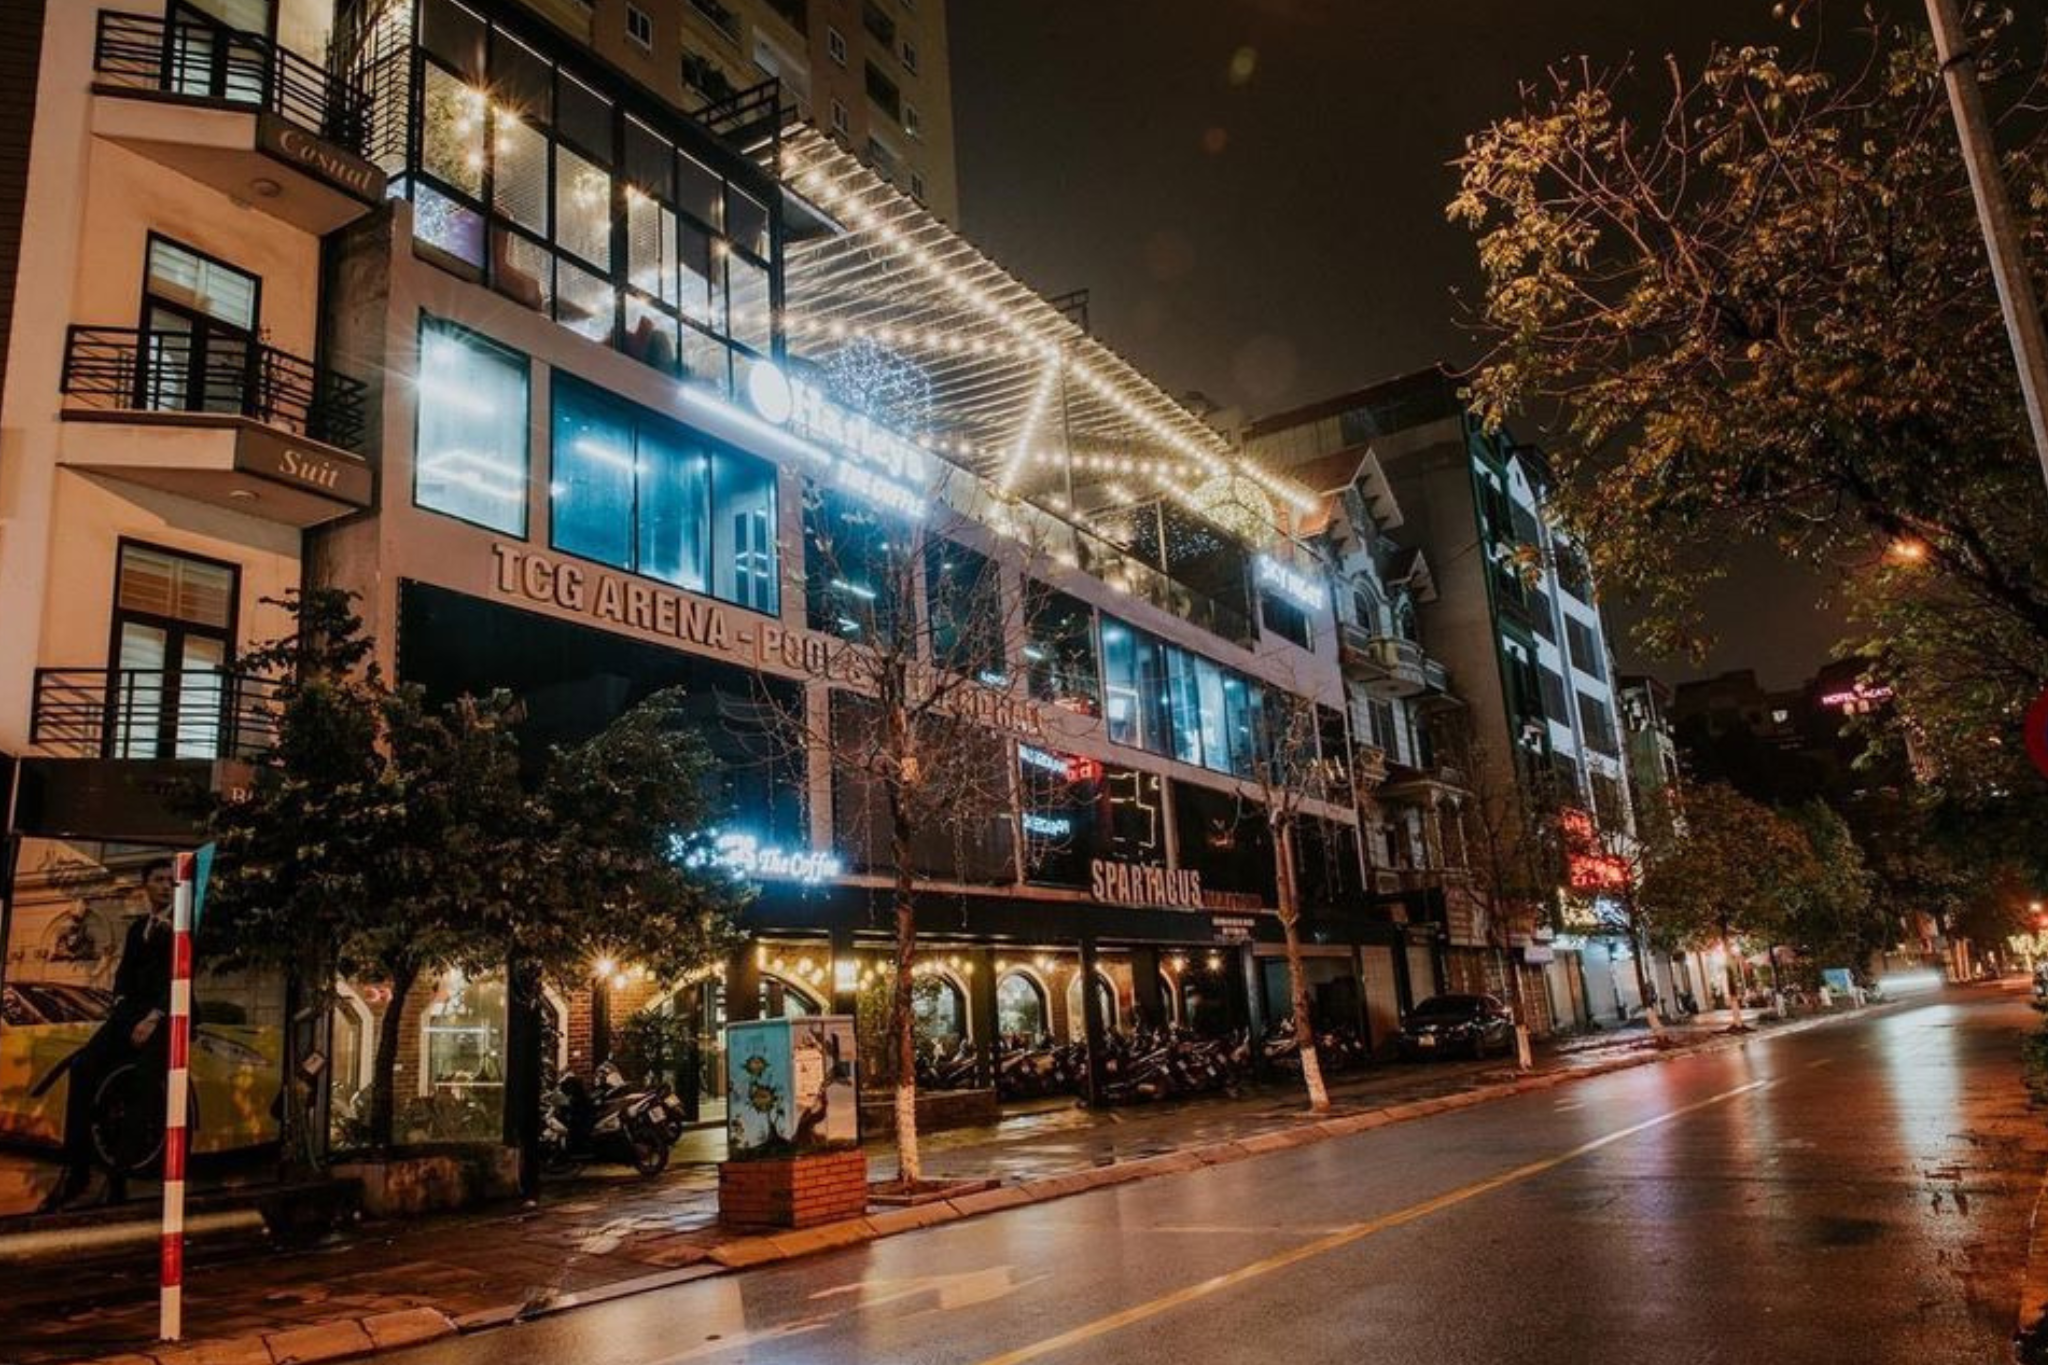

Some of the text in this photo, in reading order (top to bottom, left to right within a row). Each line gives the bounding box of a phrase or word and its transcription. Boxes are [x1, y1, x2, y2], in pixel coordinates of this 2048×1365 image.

[279, 450, 338, 488] Suit
[493, 543, 584, 611] TCG
[595, 575, 730, 649] ARENA
[759, 848, 788, 872] The
[1092, 858, 1203, 908] SPARTACUS
